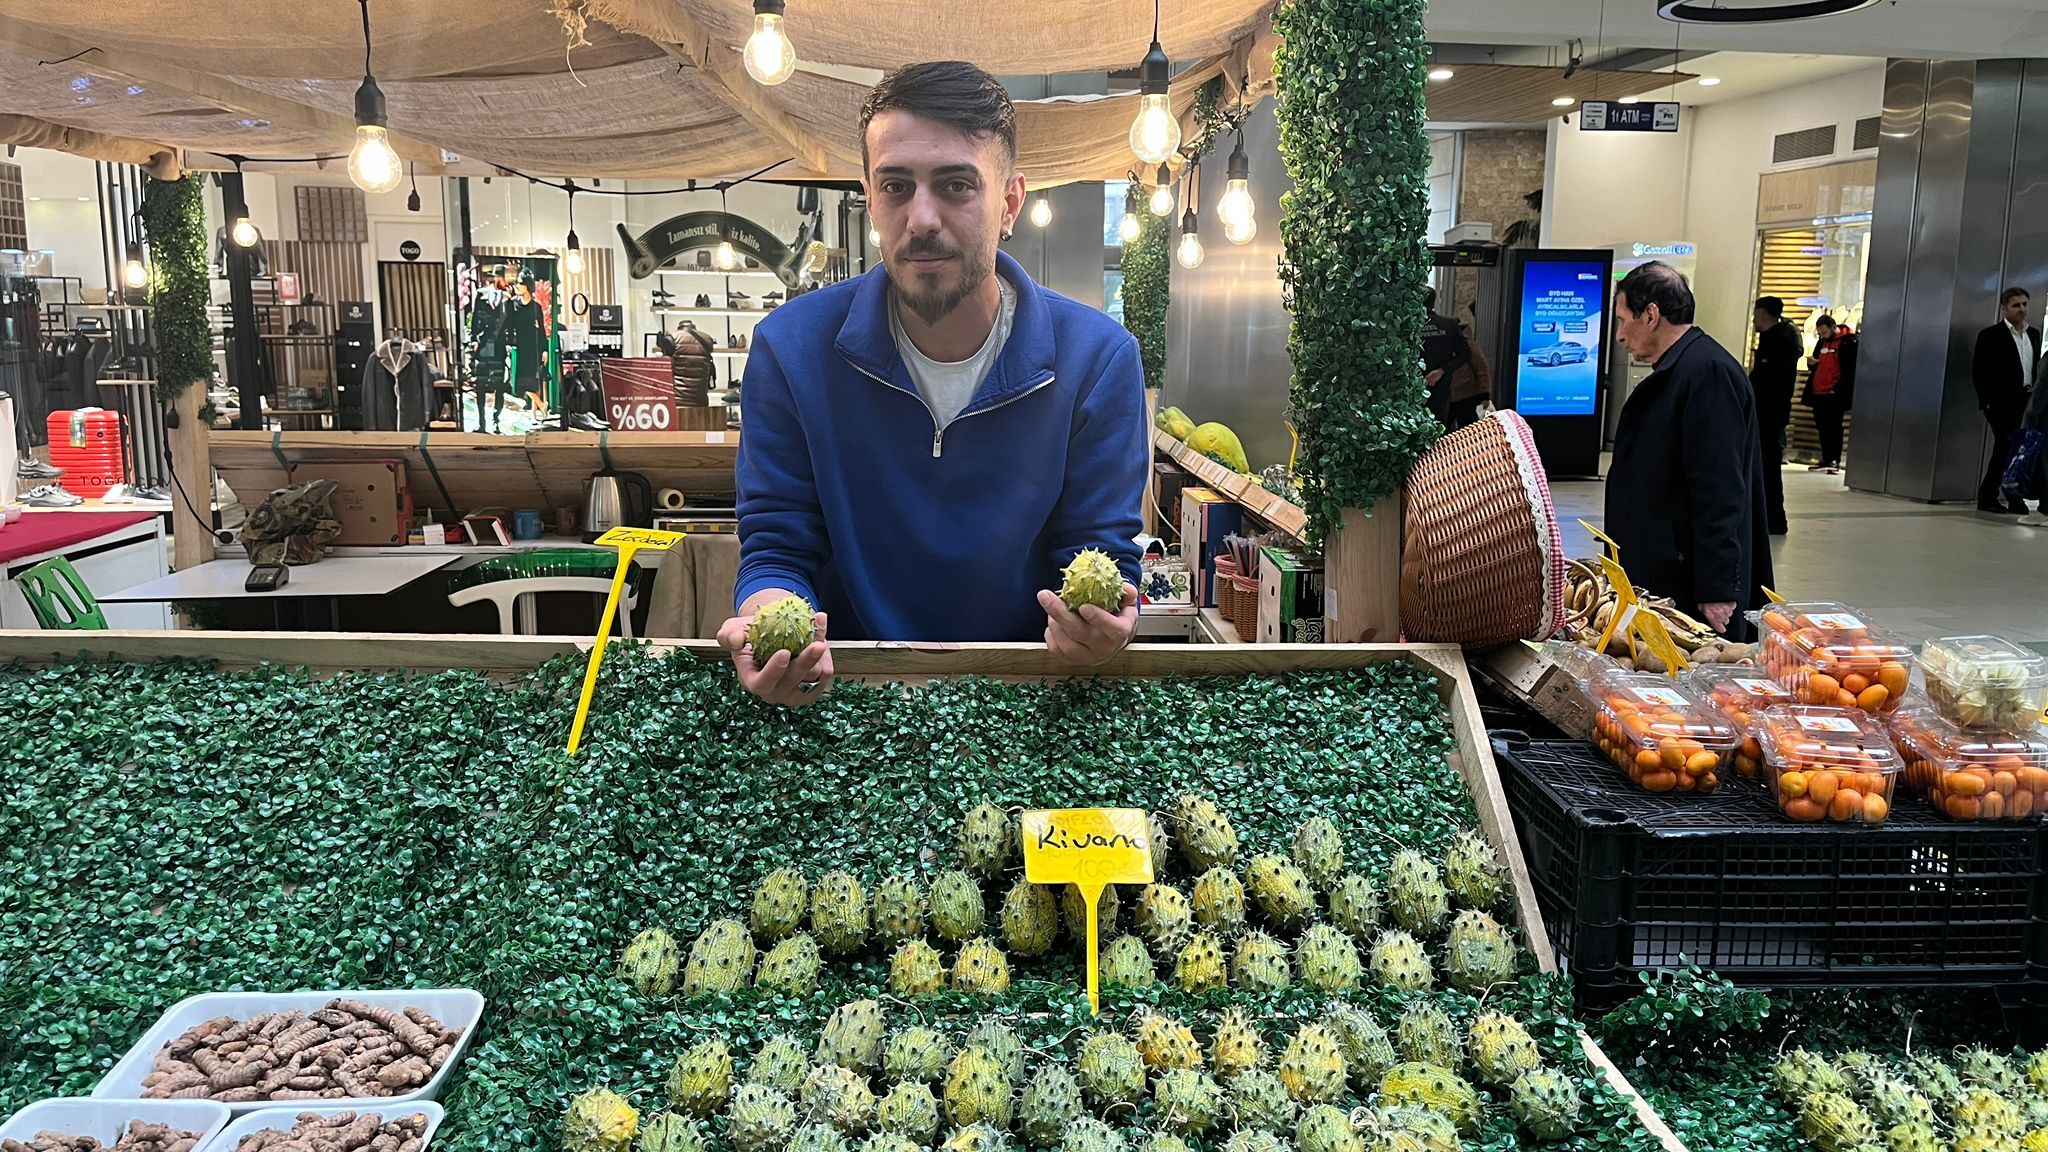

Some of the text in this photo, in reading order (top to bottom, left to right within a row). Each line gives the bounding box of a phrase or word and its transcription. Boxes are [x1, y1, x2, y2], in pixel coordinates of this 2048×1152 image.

[1620, 109, 1640, 123] ATM
[667, 226, 704, 245] Zamansız
[401, 246, 420, 255] TOGO
[612, 403, 670, 430] %60
[1037, 824, 1148, 850] Kivano
